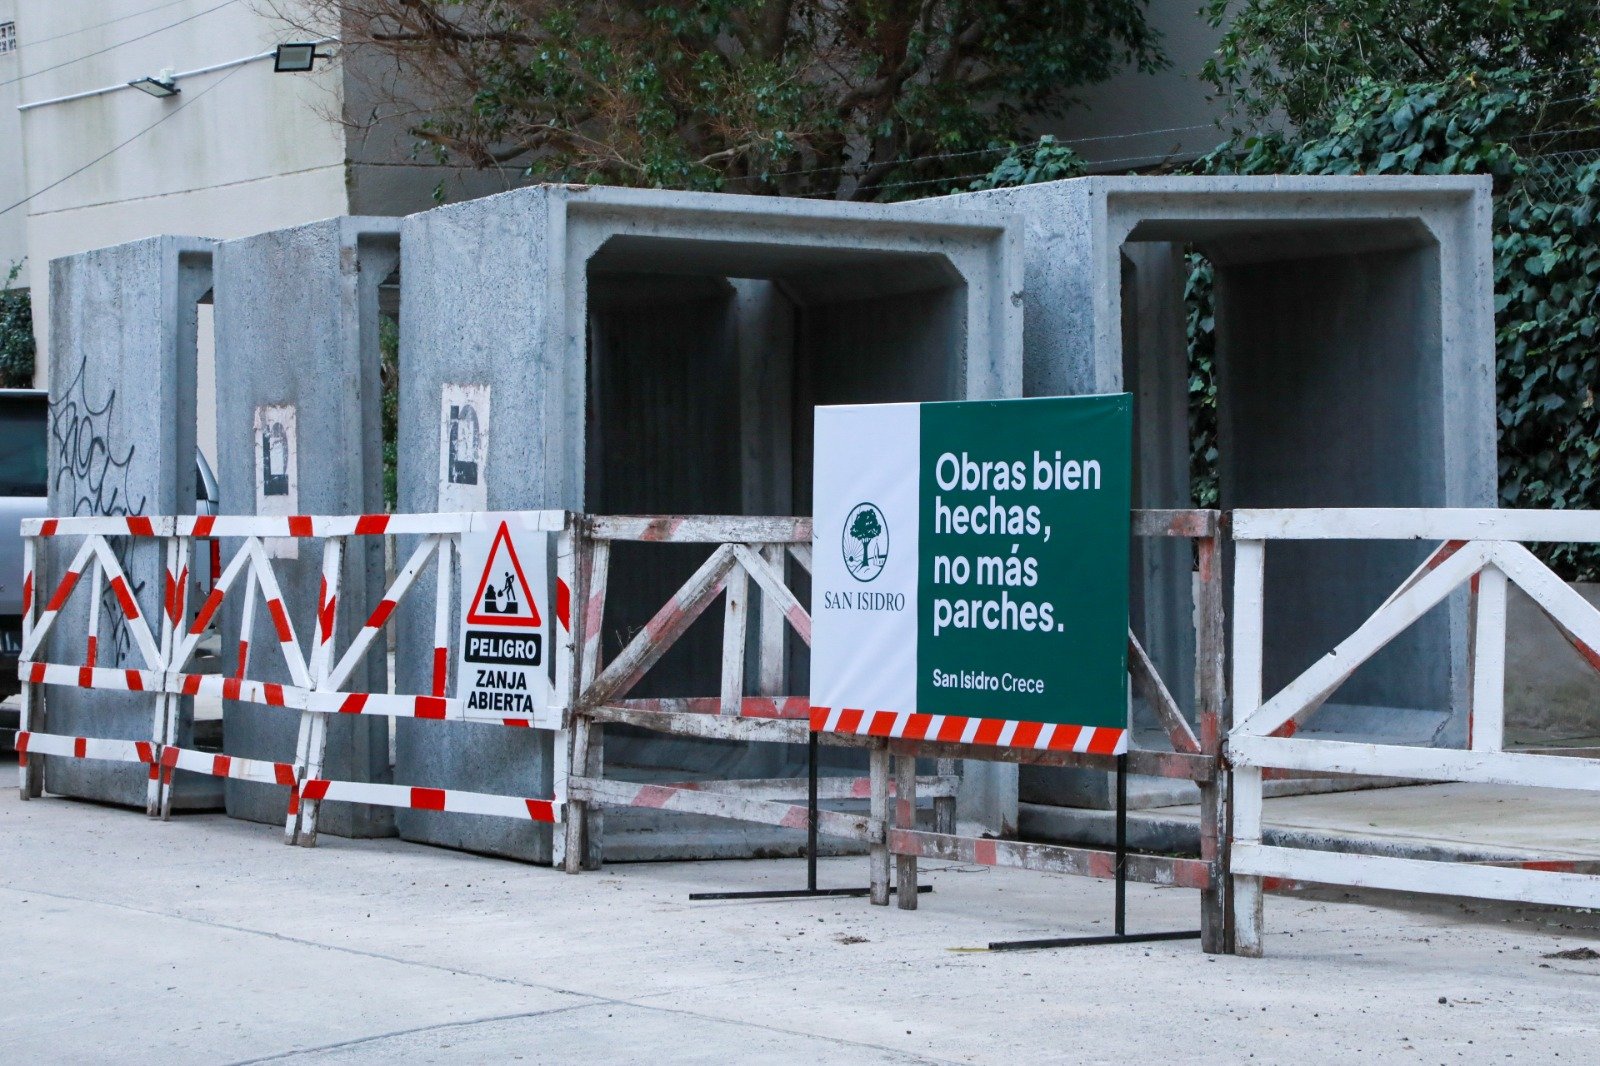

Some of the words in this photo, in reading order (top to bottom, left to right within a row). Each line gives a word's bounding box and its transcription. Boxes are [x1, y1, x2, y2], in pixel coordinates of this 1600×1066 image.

[935, 451, 1027, 491] Obras
[1033, 450, 1101, 490] bien
[935, 495, 1051, 543] hechas,
[934, 555, 971, 585] no
[976, 543, 1039, 587] más
[824, 590, 853, 610] SAN
[857, 591, 905, 612] ISIDRO
[933, 590, 1065, 637] parches.
[469, 637, 537, 660] PELIGRO
[475, 669, 527, 690] ZANJA
[932, 668, 959, 688] San
[960, 669, 999, 691] Isidro
[1001, 672, 1045, 694] Crece
[467, 691, 534, 713] ABIERTA
